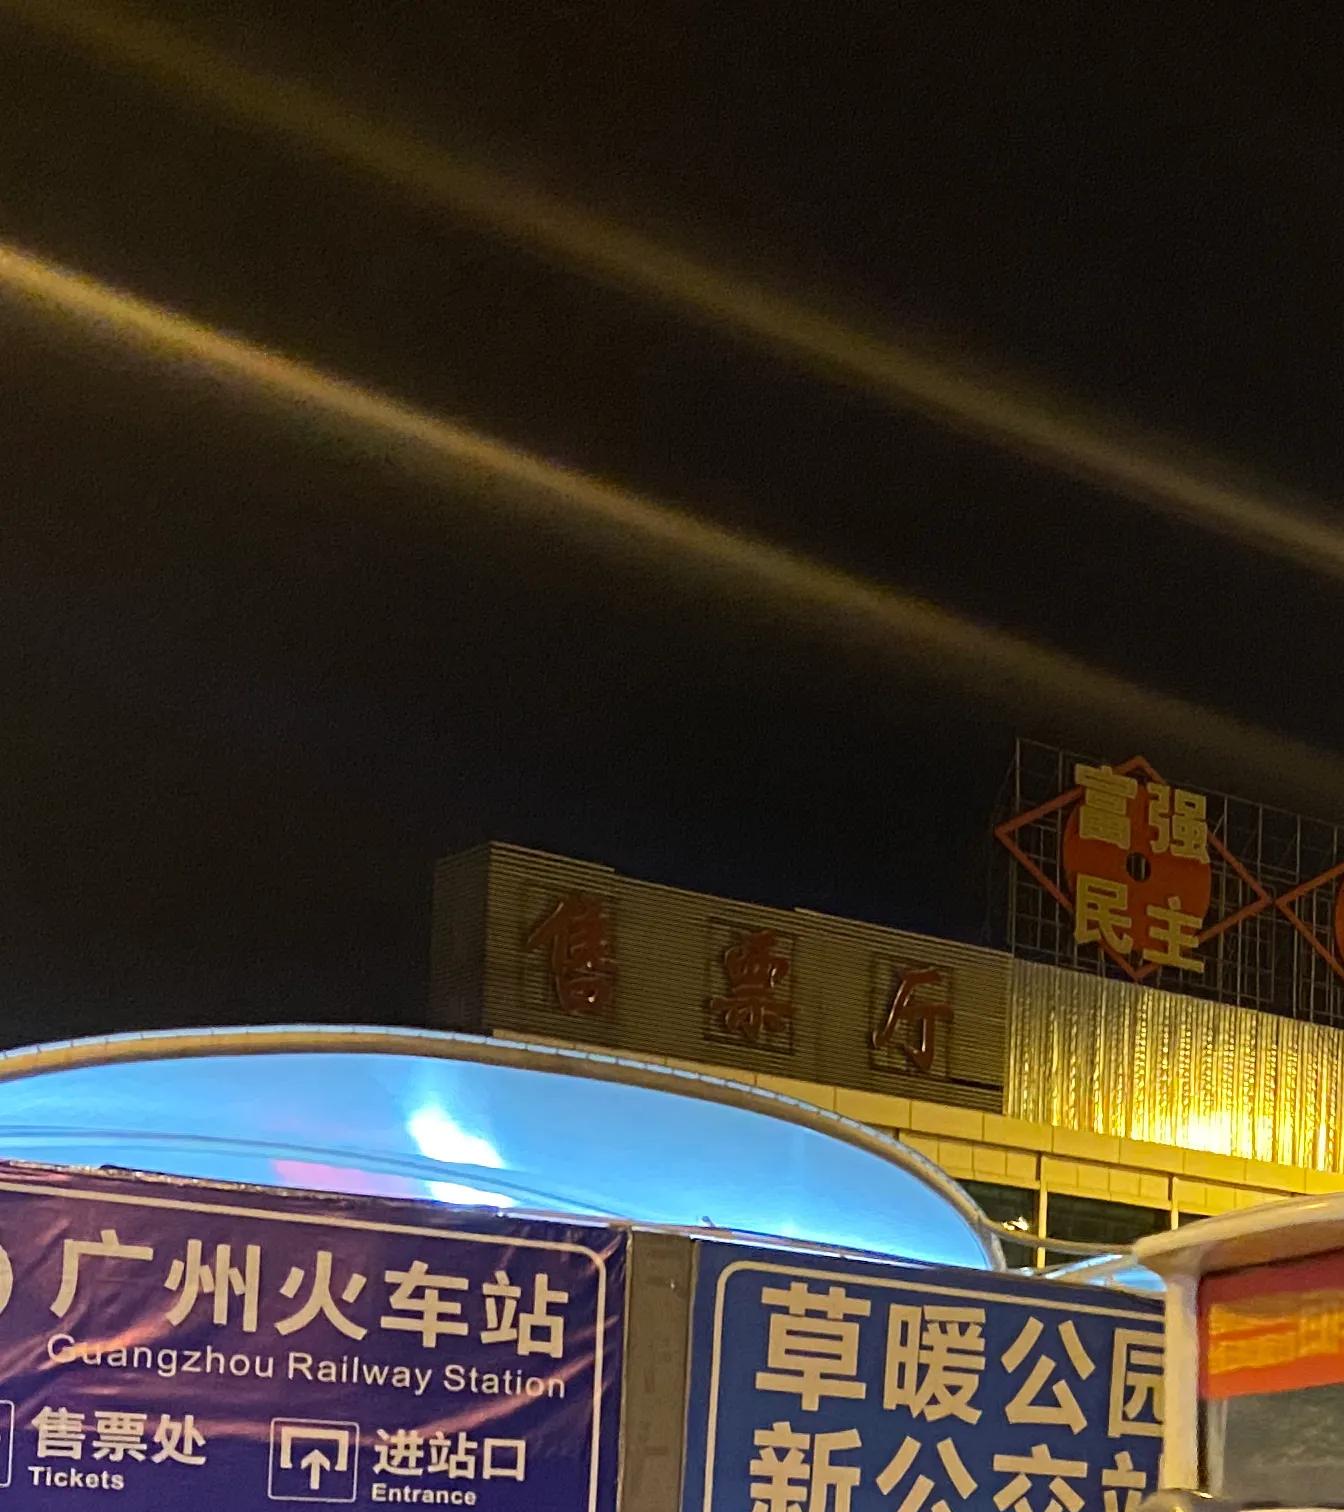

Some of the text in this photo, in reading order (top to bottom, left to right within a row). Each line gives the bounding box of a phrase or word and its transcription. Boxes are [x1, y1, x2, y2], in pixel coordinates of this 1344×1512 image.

[1074, 764, 1209, 864] 富强
[1074, 874, 1205, 973] 民主
[50, 1229, 569, 1359] 广州火车站
[47, 1333, 566, 1399] Guangzhou Railway Station
[31, 1406, 207, 1466] 售票处
[373, 1429, 527, 1482] 进站口
[27, 1465, 125, 1492] Tickets
[371, 1482, 477, 1507] Entrance
